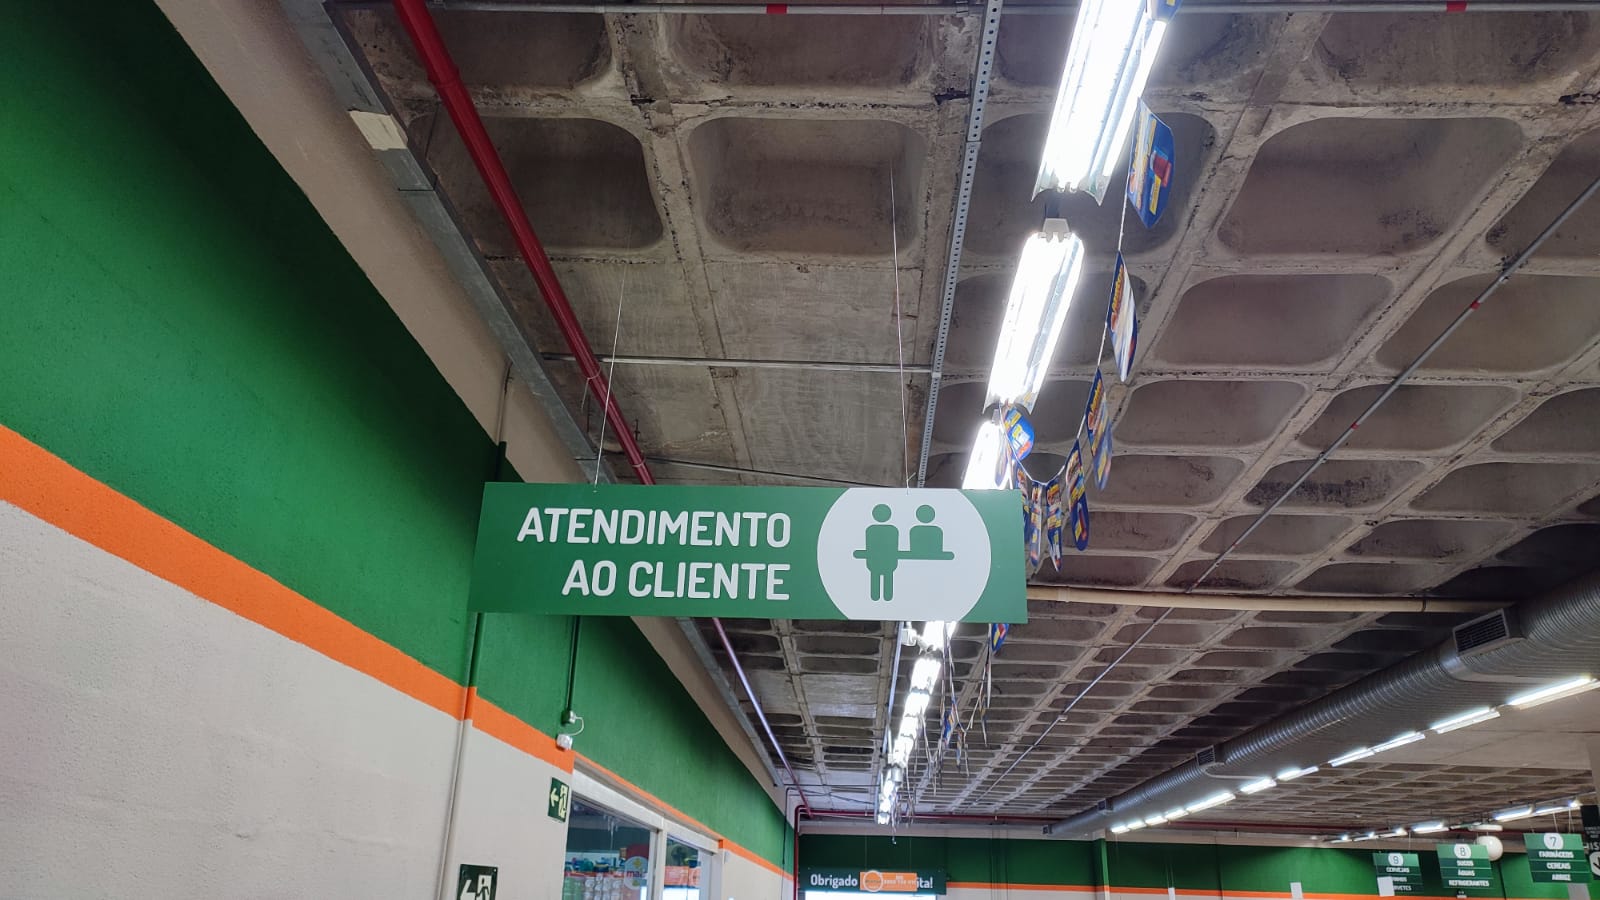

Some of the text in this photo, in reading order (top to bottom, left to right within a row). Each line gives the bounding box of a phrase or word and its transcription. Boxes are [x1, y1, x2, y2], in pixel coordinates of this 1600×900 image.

[516, 507, 791, 548] ATENDIMENTO
[561, 559, 791, 600] AO CLIENTE
[1550, 836, 1557, 847] 7
[1459, 847, 1466, 857] 8
[1392, 855, 1399, 865] 9
[810, 873, 858, 889] Obrigado
